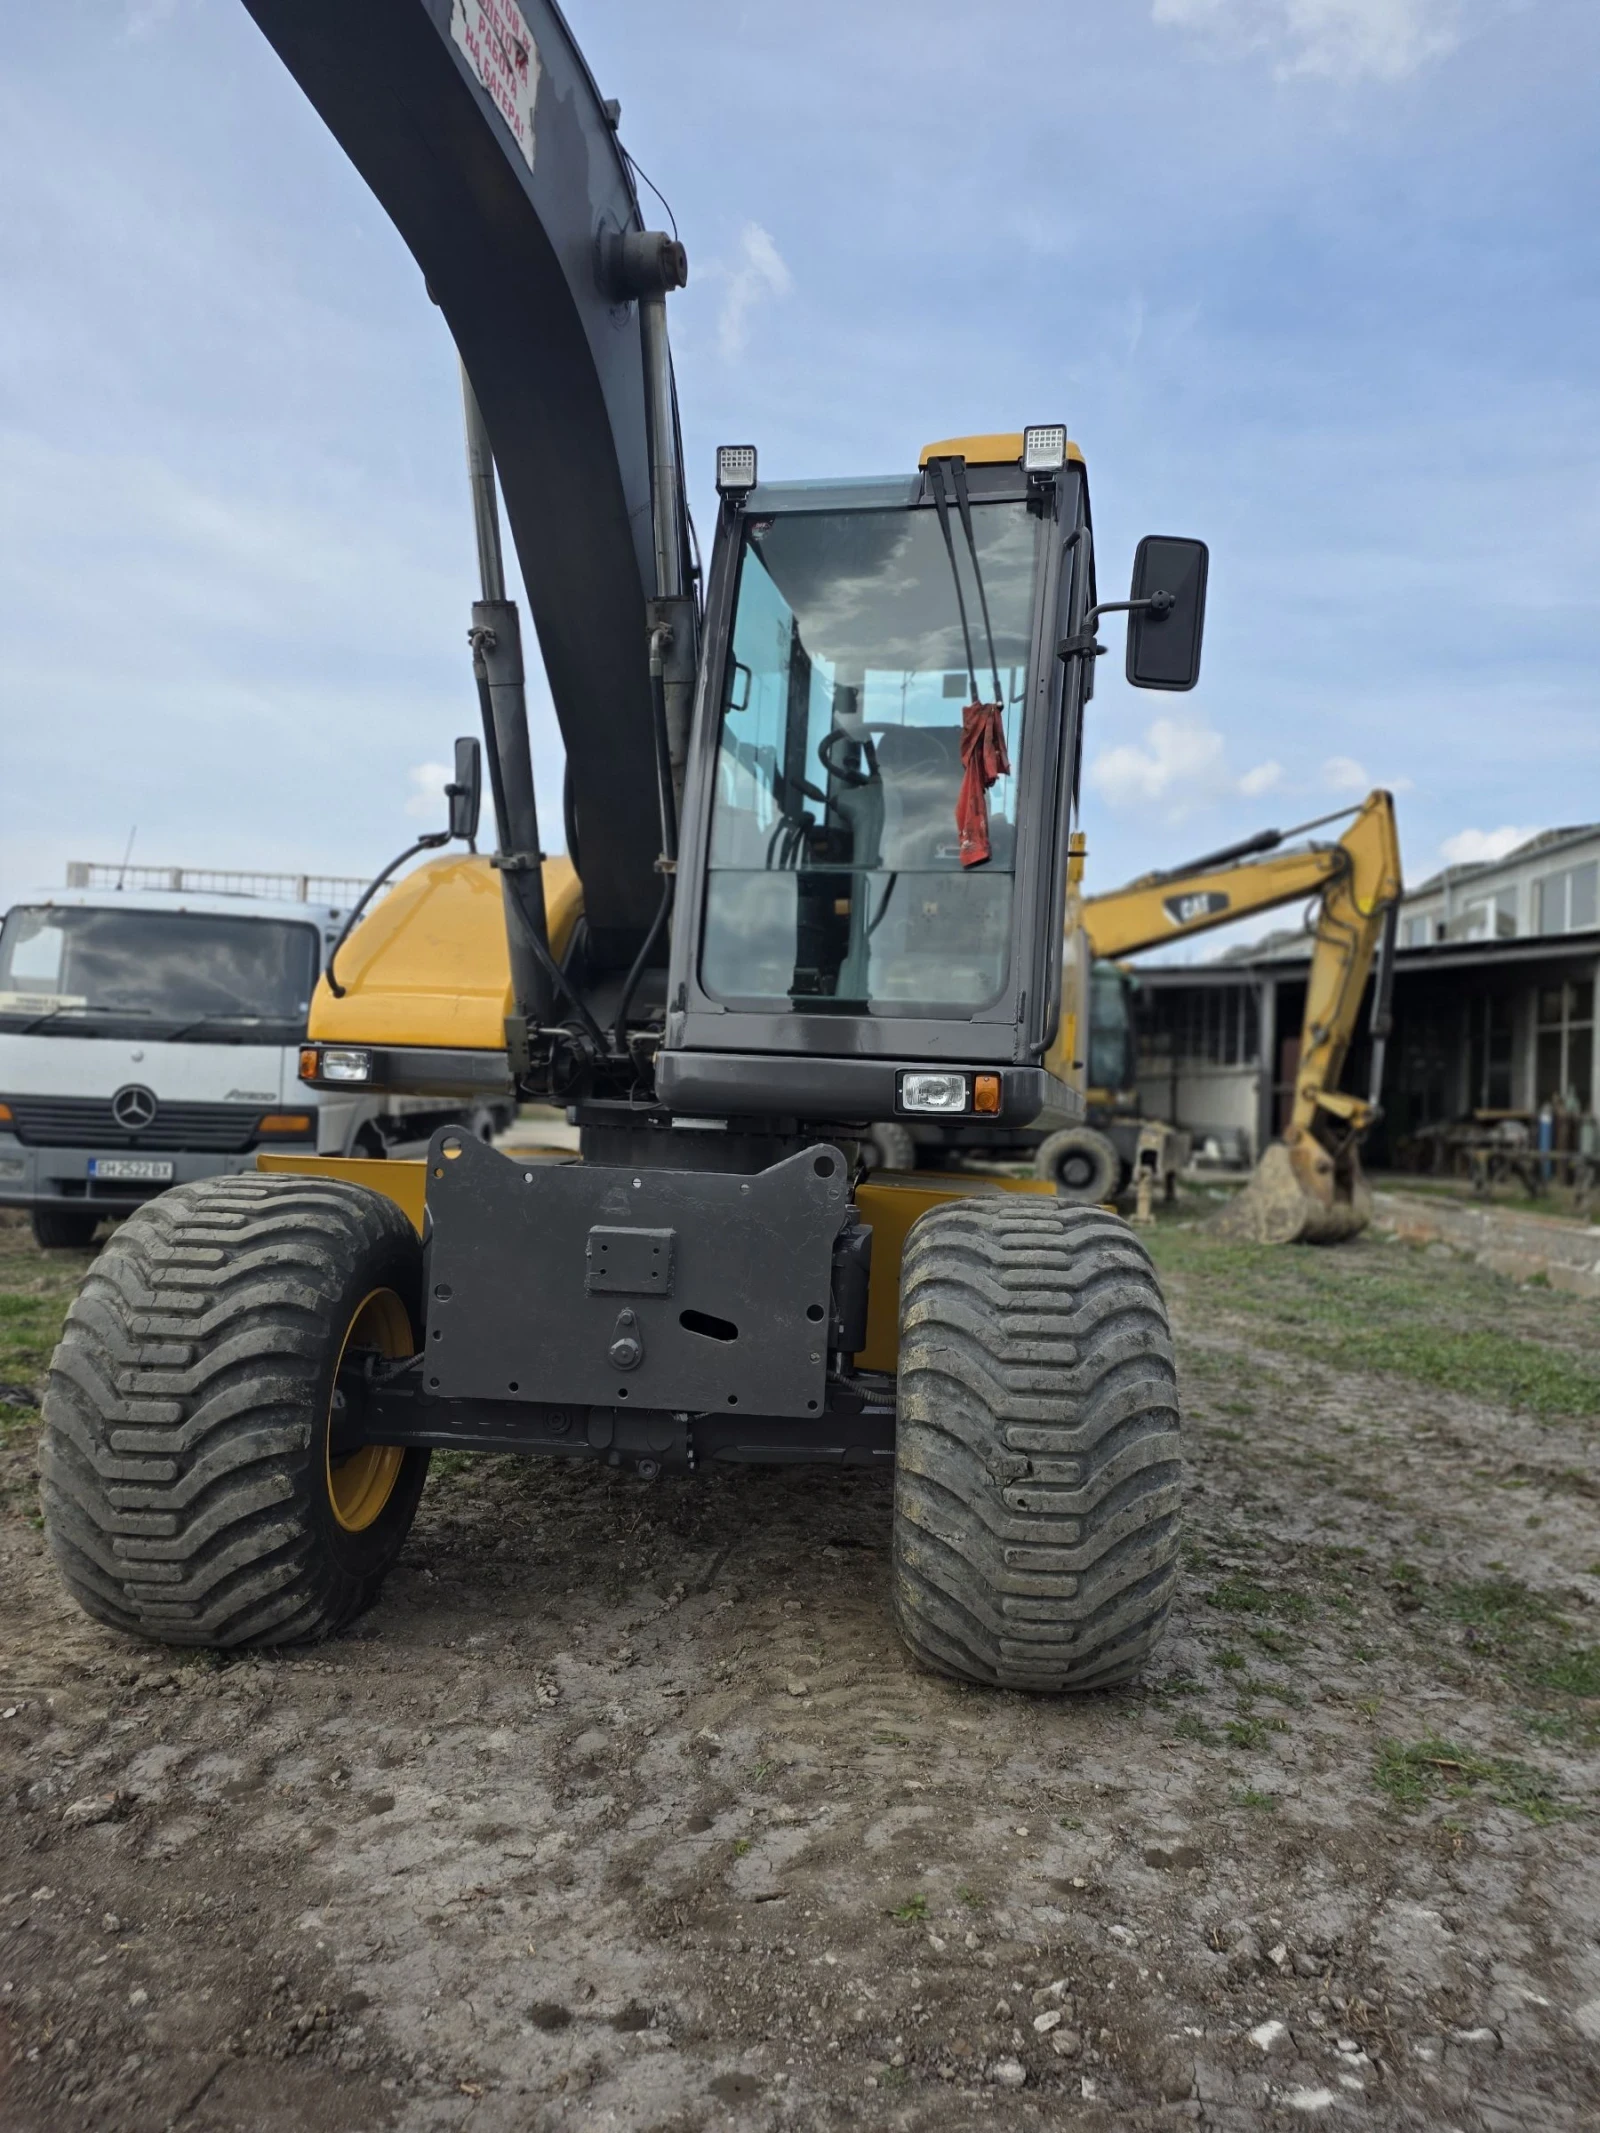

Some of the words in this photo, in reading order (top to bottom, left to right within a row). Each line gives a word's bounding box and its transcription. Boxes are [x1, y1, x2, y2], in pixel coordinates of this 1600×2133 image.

[465, 25, 480, 66] НА
[483, 57, 525, 142] БАГЕРА!
[478, 14, 517, 99] РАБОТА
[1180, 892, 1209, 920] CAT
